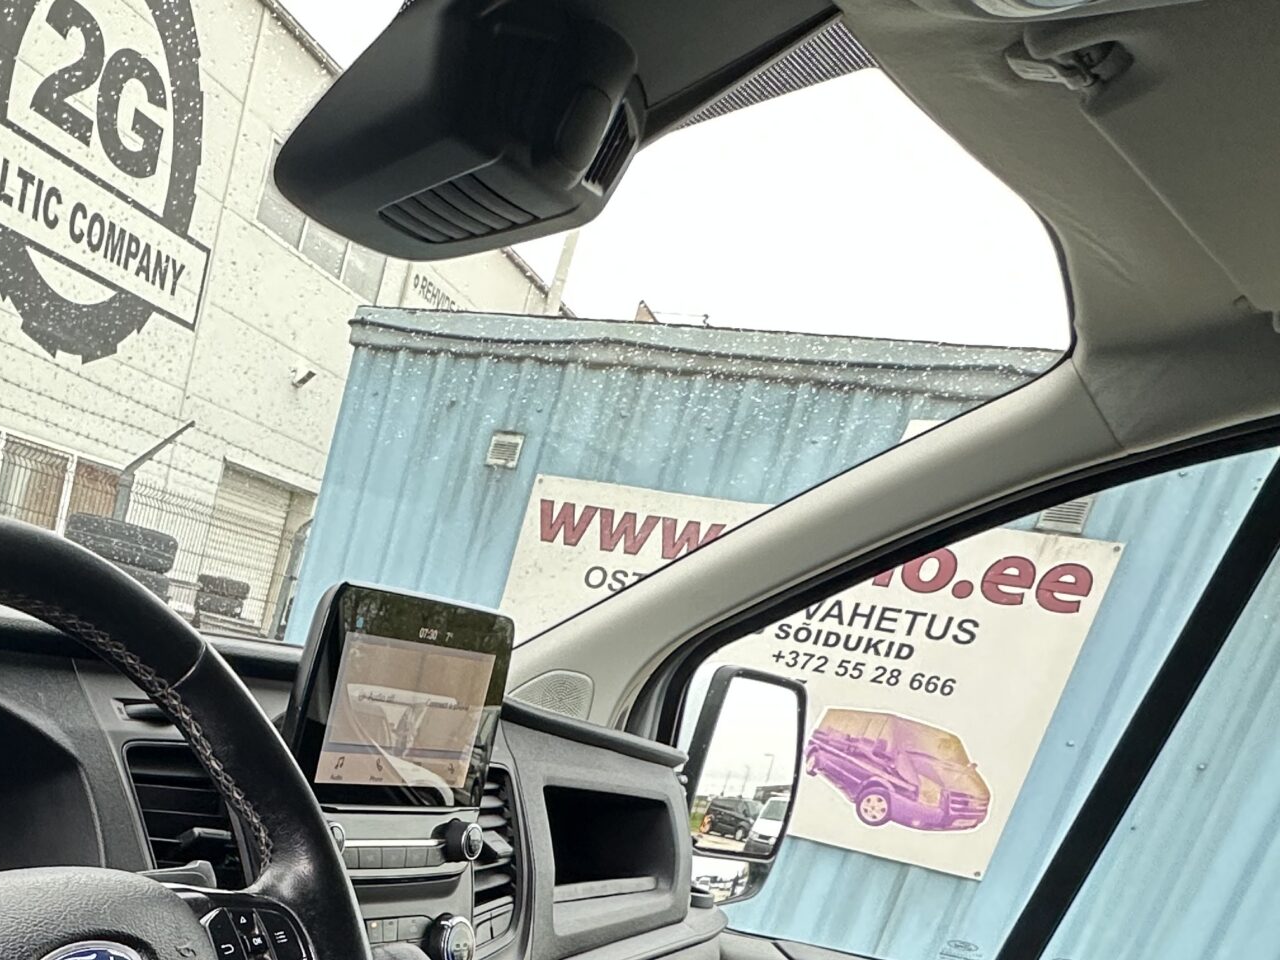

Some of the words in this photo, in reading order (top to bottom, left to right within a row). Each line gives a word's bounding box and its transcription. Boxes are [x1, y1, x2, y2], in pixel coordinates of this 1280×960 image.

[29, 0, 168, 179] 2G
[69, 202, 186, 296] COMPANY
[771, 649, 829, 674] +372
[835, 660, 864, 680] 55
[870, 666, 902, 687] 28
[909, 673, 956, 697] 666
[774, 622, 915, 661] SÕIDUKID
